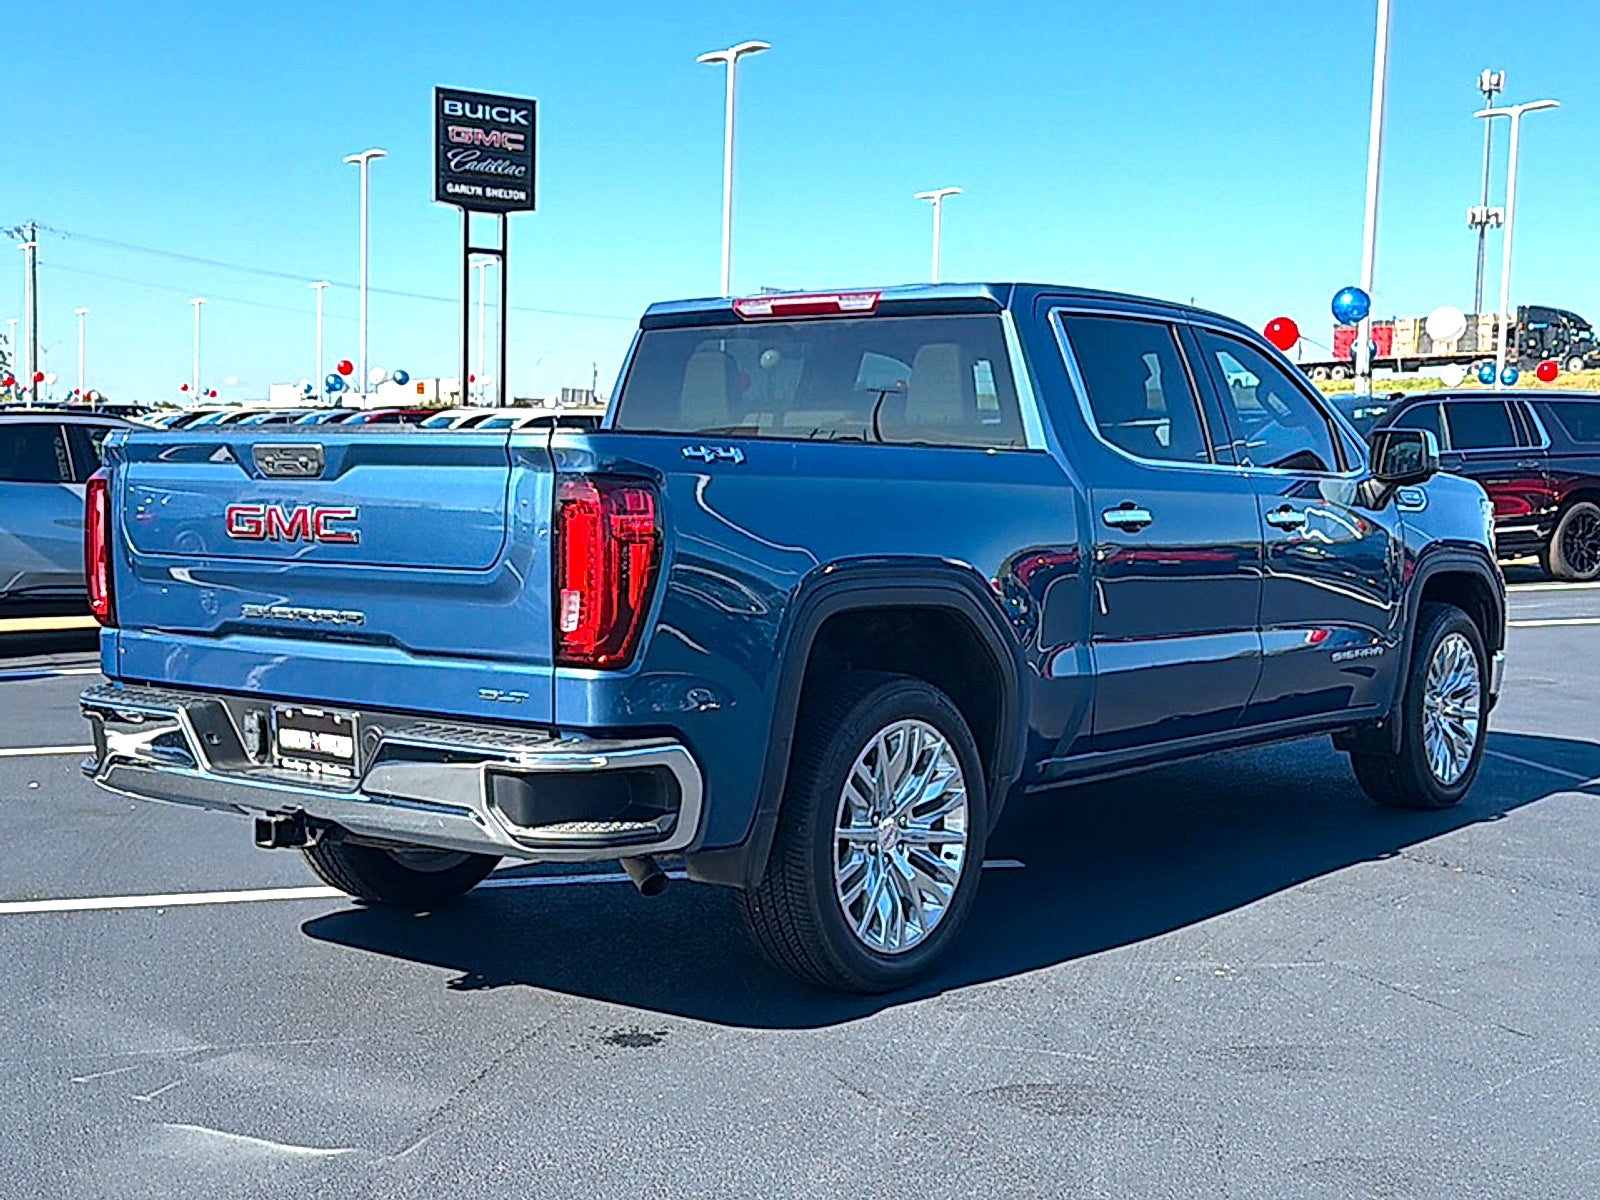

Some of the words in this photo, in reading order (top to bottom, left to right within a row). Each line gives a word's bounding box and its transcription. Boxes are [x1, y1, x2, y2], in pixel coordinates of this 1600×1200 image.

[443, 99, 529, 126] BUICK
[447, 125, 525, 151] GMC
[446, 148, 526, 177] Cadillac
[446, 182, 483, 197] GARLYN
[485, 187, 527, 201] SHELTON
[225, 503, 361, 544] GMC
[241, 603, 365, 625] SIERRA
[1331, 646, 1384, 663] SIERRA
